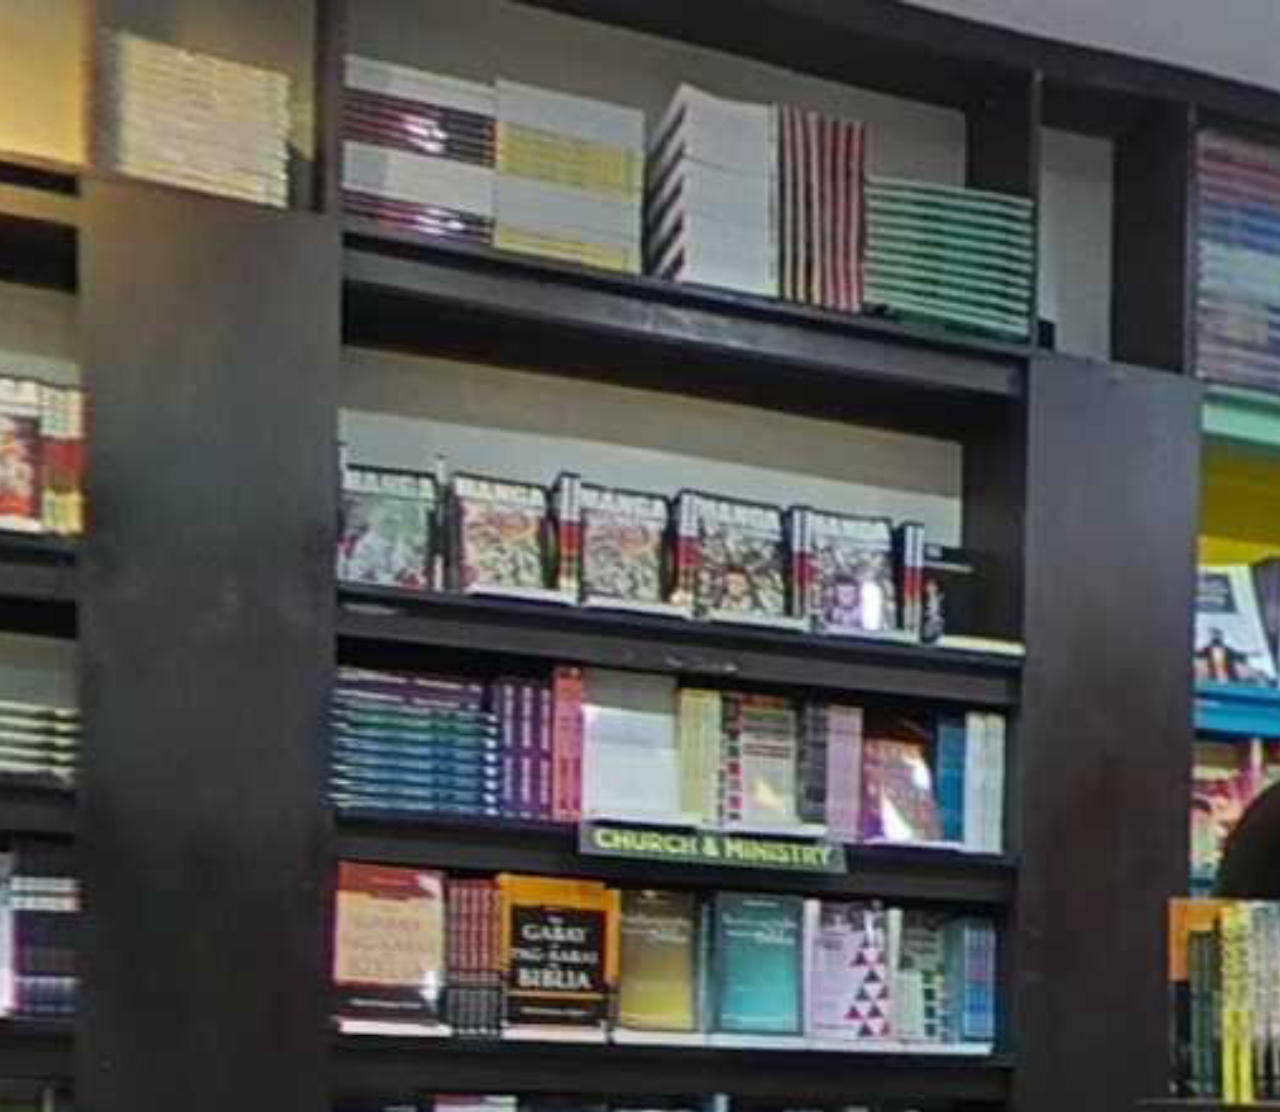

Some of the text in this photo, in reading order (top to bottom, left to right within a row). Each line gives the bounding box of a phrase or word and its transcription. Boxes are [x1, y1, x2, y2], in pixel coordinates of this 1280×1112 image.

[595, 827, 832, 866] CHURCH & MINISTRY
